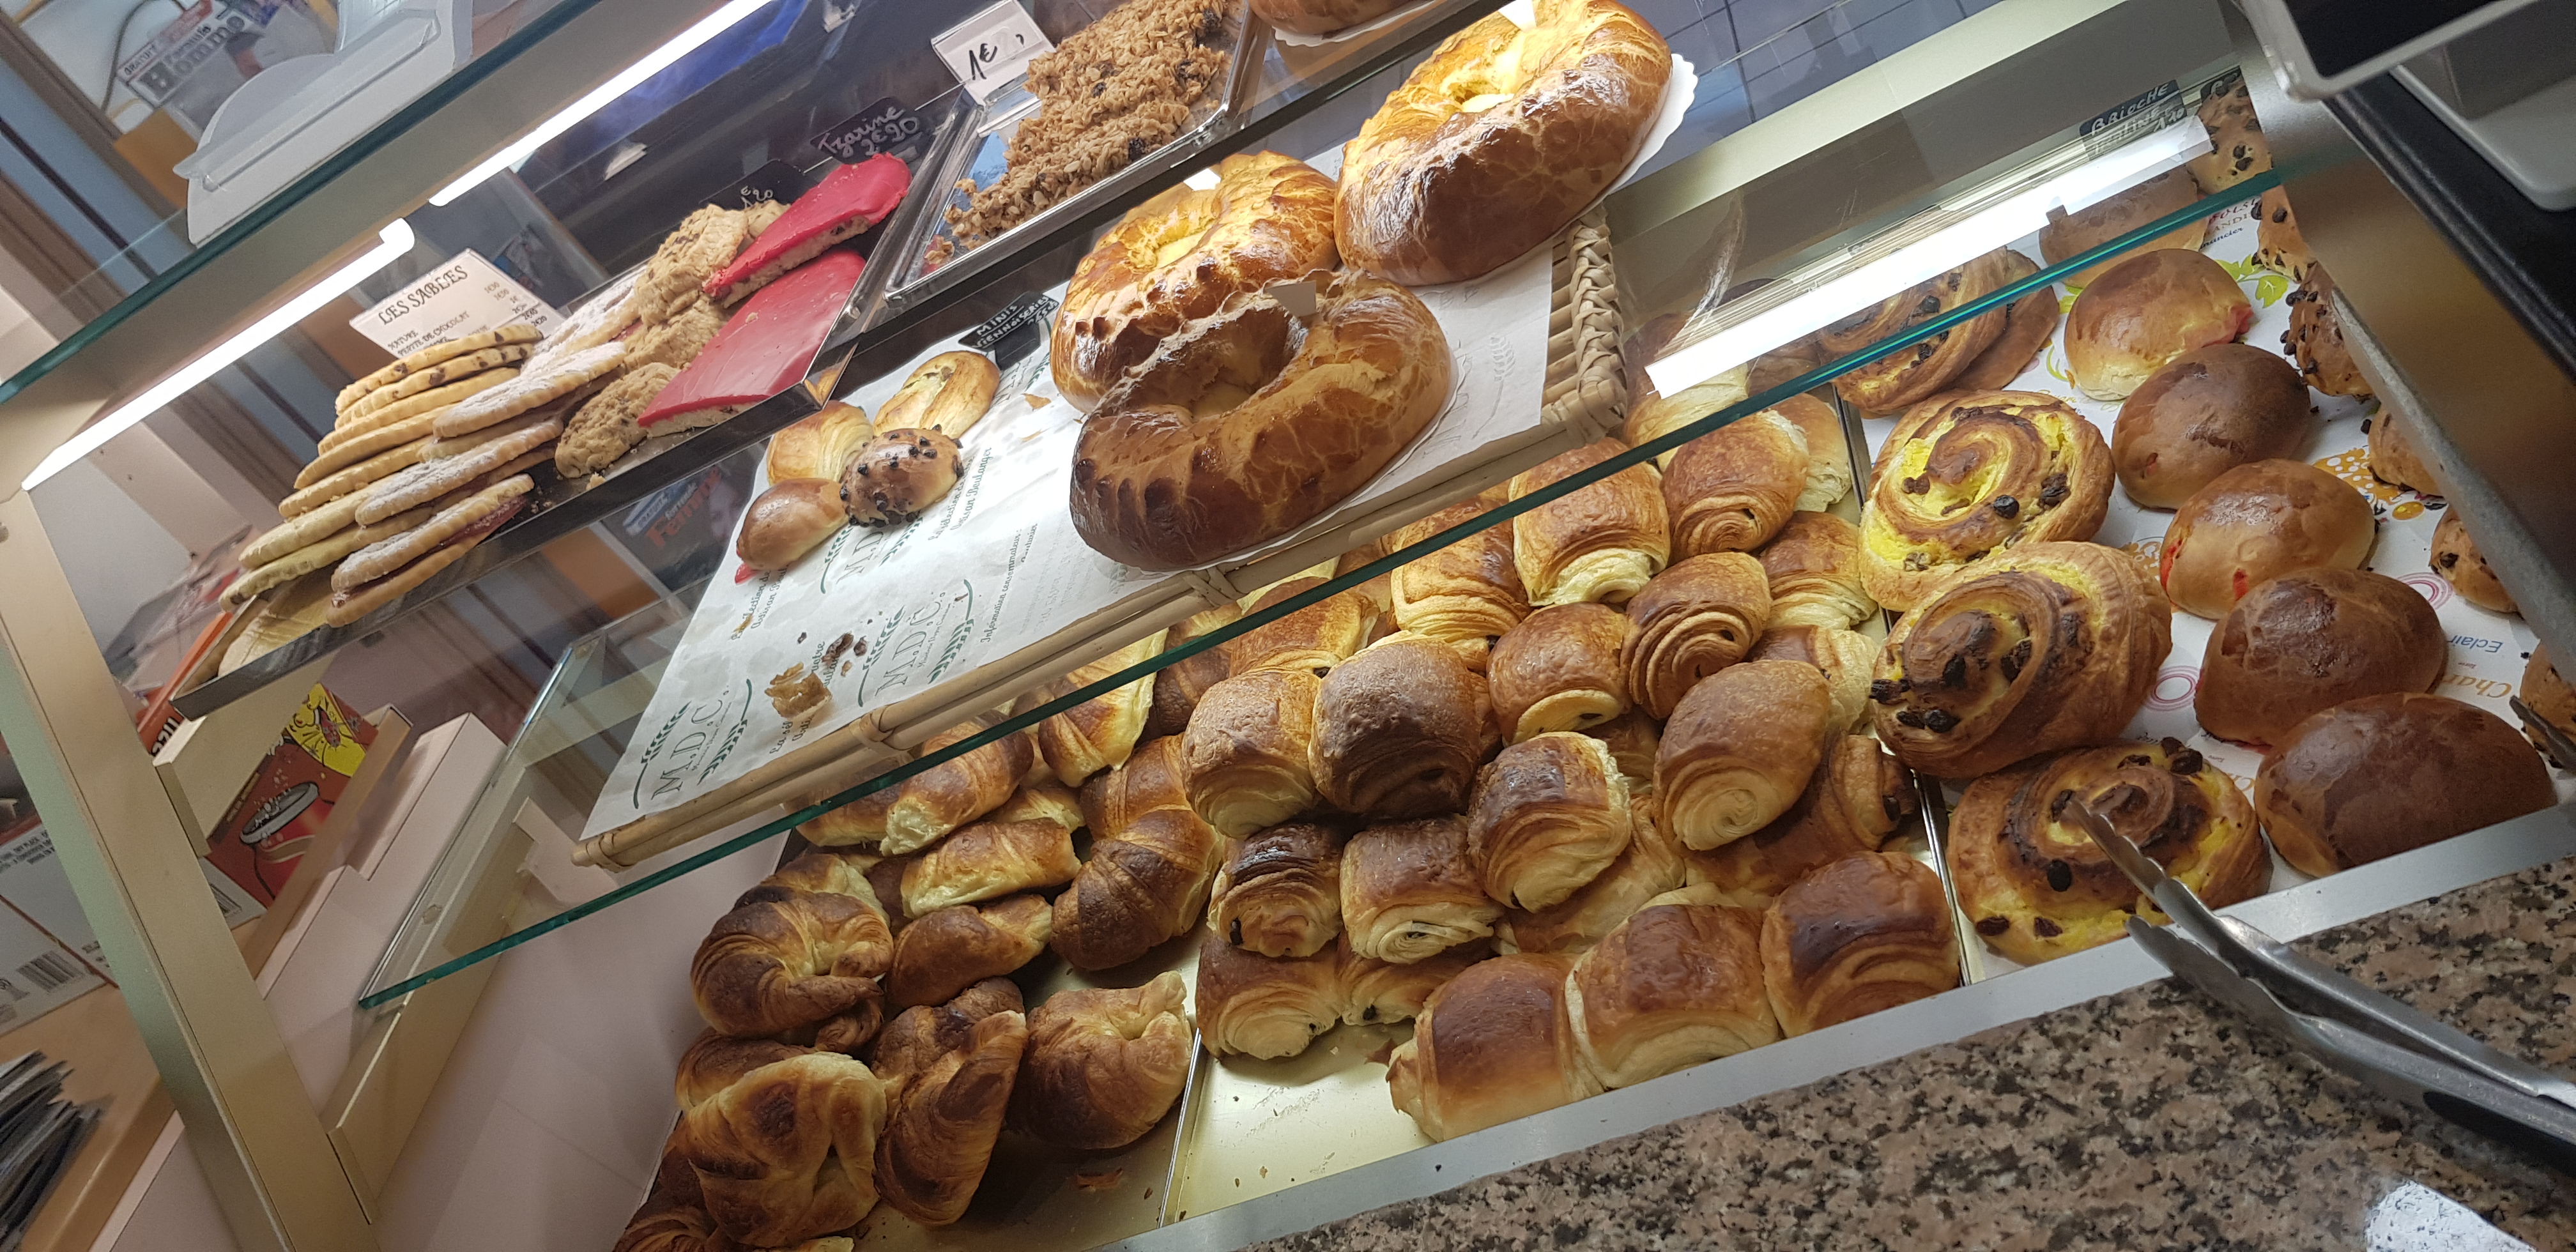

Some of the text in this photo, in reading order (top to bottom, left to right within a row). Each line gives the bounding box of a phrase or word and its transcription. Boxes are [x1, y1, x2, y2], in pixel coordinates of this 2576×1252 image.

[818, 106, 906, 158] Tzarine
[378, 300, 410, 325] LES
[965, 447, 993, 496] Boulanger
